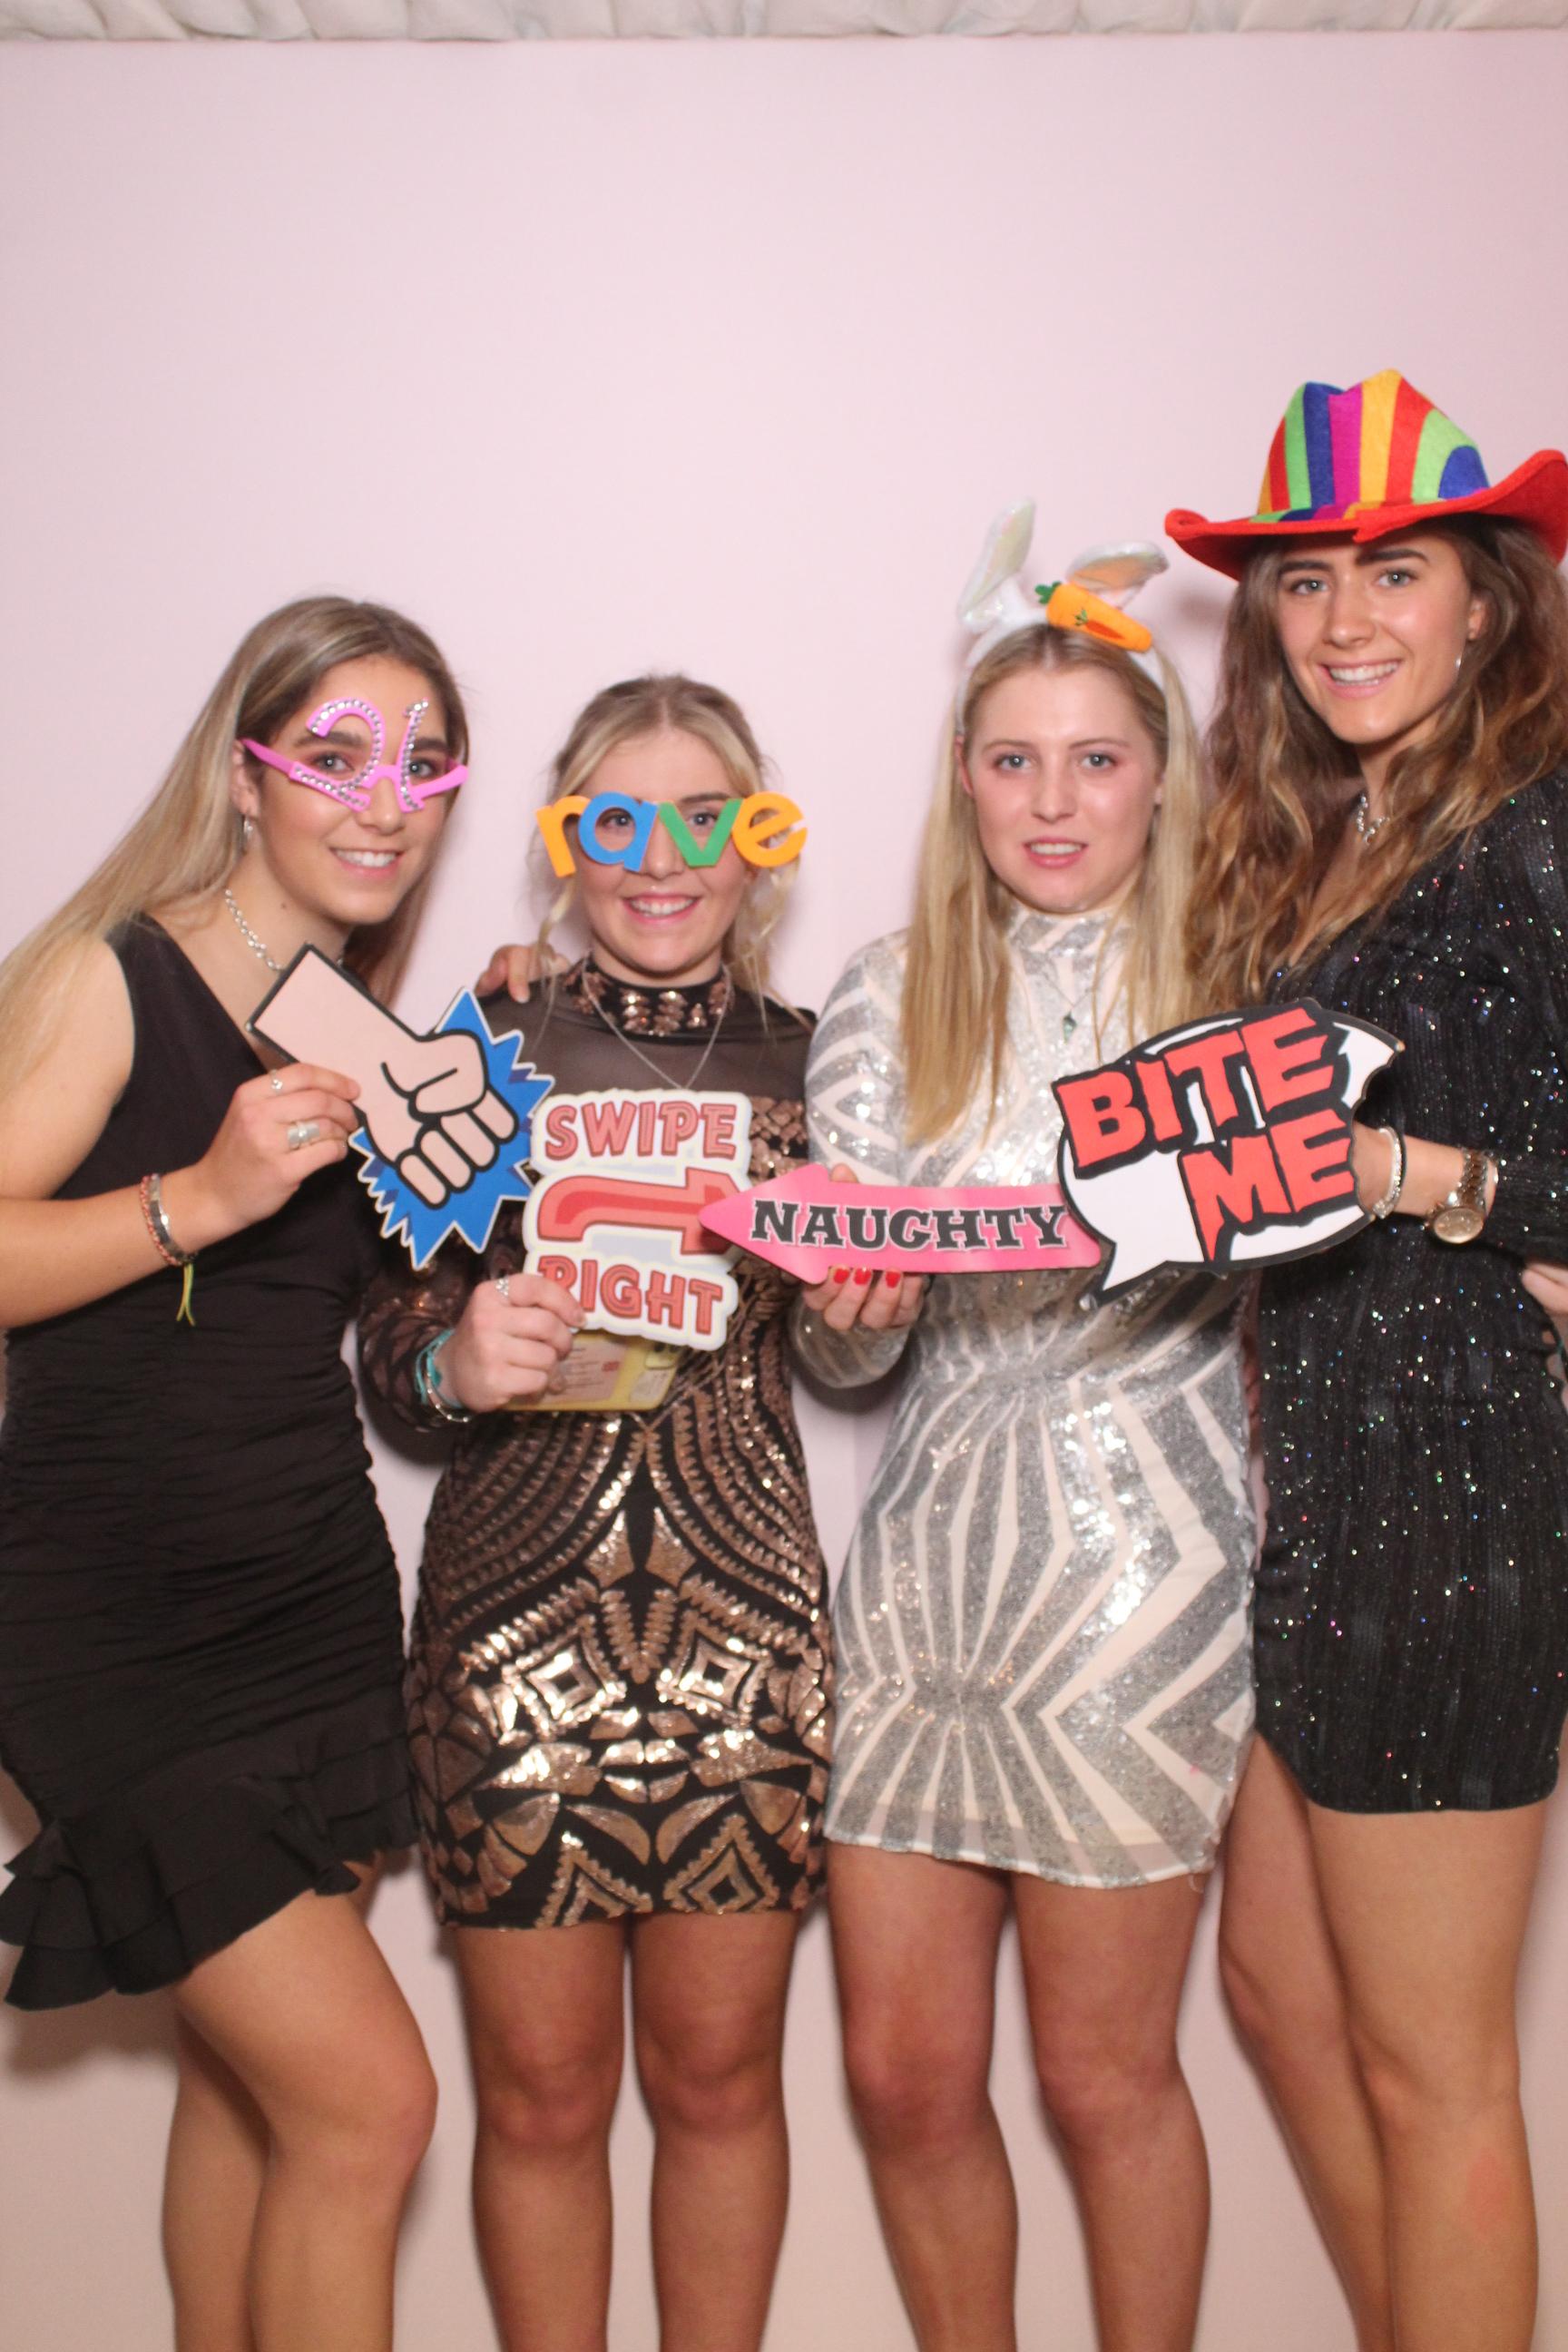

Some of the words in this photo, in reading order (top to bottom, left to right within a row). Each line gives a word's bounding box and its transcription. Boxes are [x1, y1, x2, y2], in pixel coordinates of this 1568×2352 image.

[535, 791, 808, 878] rave
[545, 1100, 738, 1161] SWIPE
[1056, 1007, 1335, 1169] BITE
[750, 1198, 1069, 1251] NAUGHTY
[1181, 1108, 1356, 1262] ME
